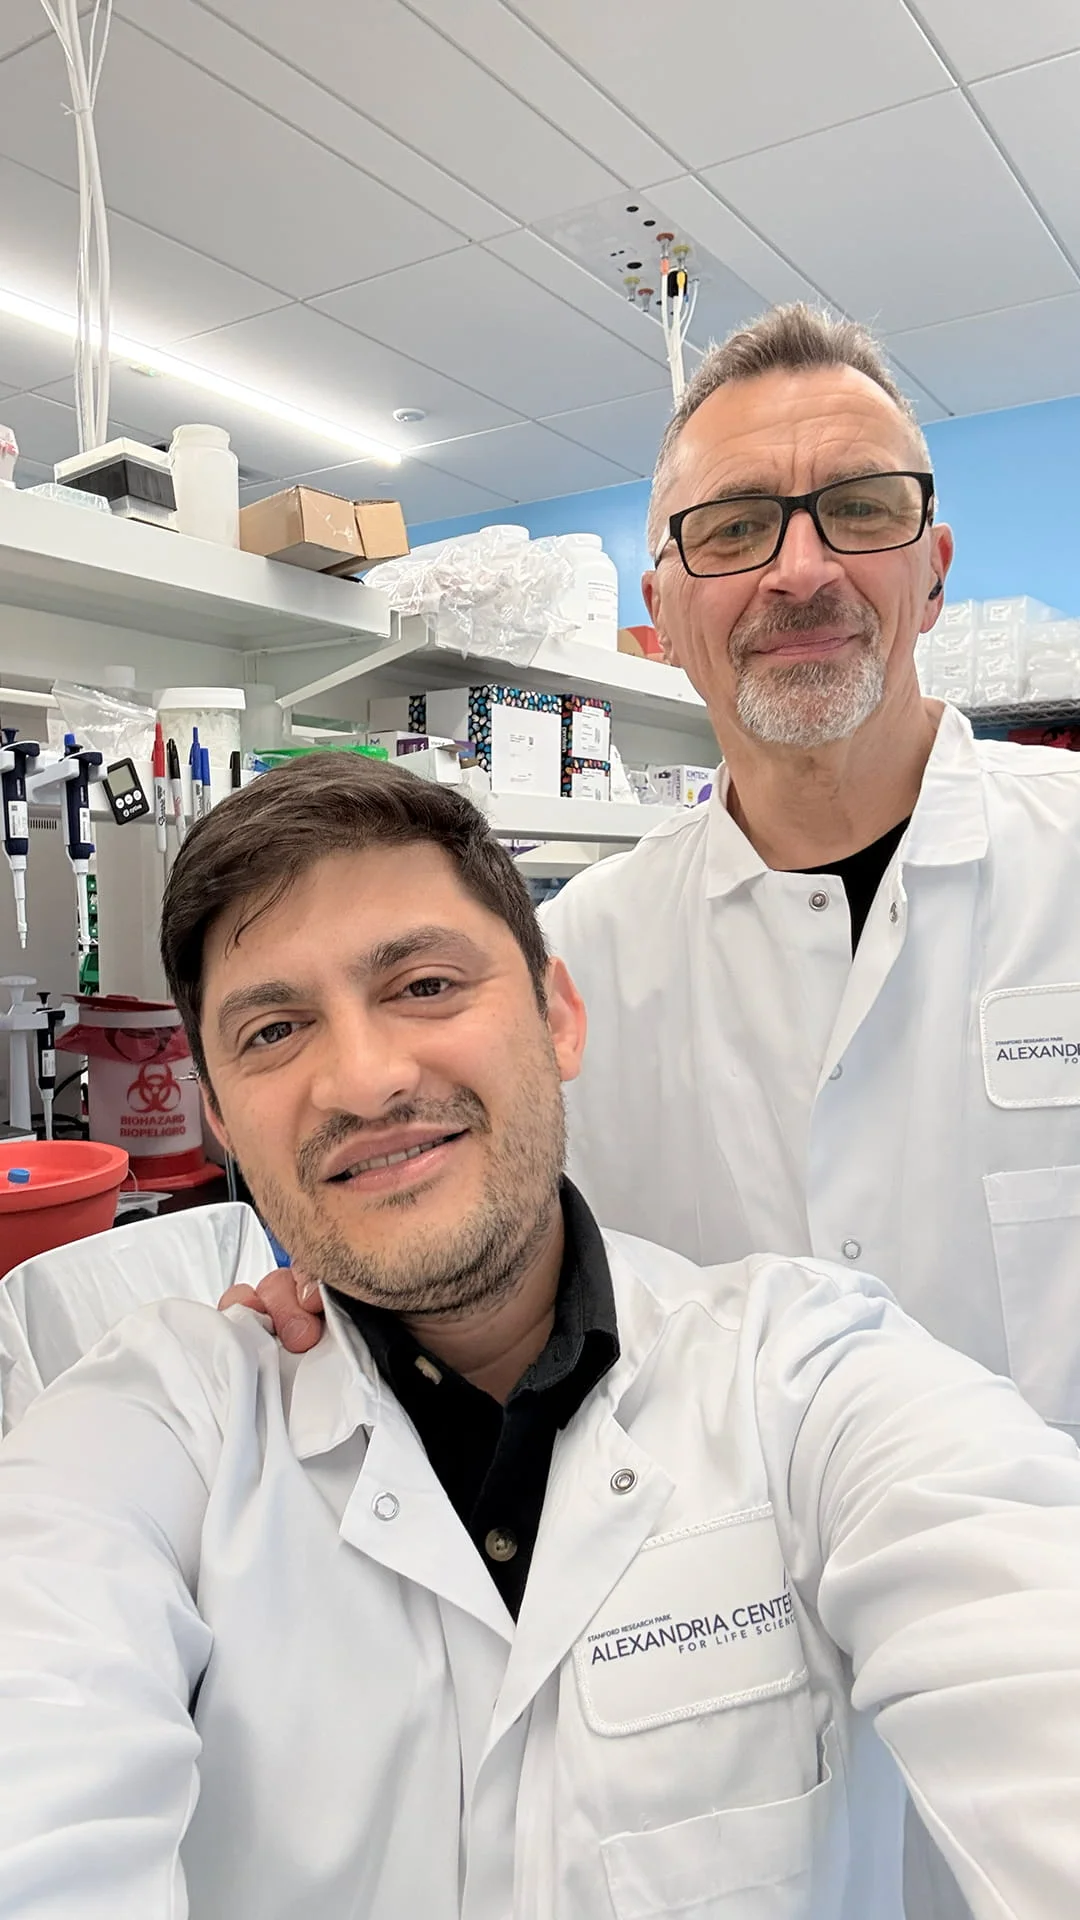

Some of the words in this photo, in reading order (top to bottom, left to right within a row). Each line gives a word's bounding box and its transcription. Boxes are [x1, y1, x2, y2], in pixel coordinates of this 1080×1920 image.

[120, 1114, 185, 1126] BIOHAZARD
[120, 1126, 186, 1137] BIOPELIGRO
[587, 1628, 620, 1643] STANFORD
[620, 1618, 654, 1633] RESEARCH
[654, 1613, 672, 1624] PARK
[591, 1613, 730, 1666] ALEXANDRIA
[678, 1640, 707, 1654] FOR
[715, 1629, 748, 1645] LIFE
